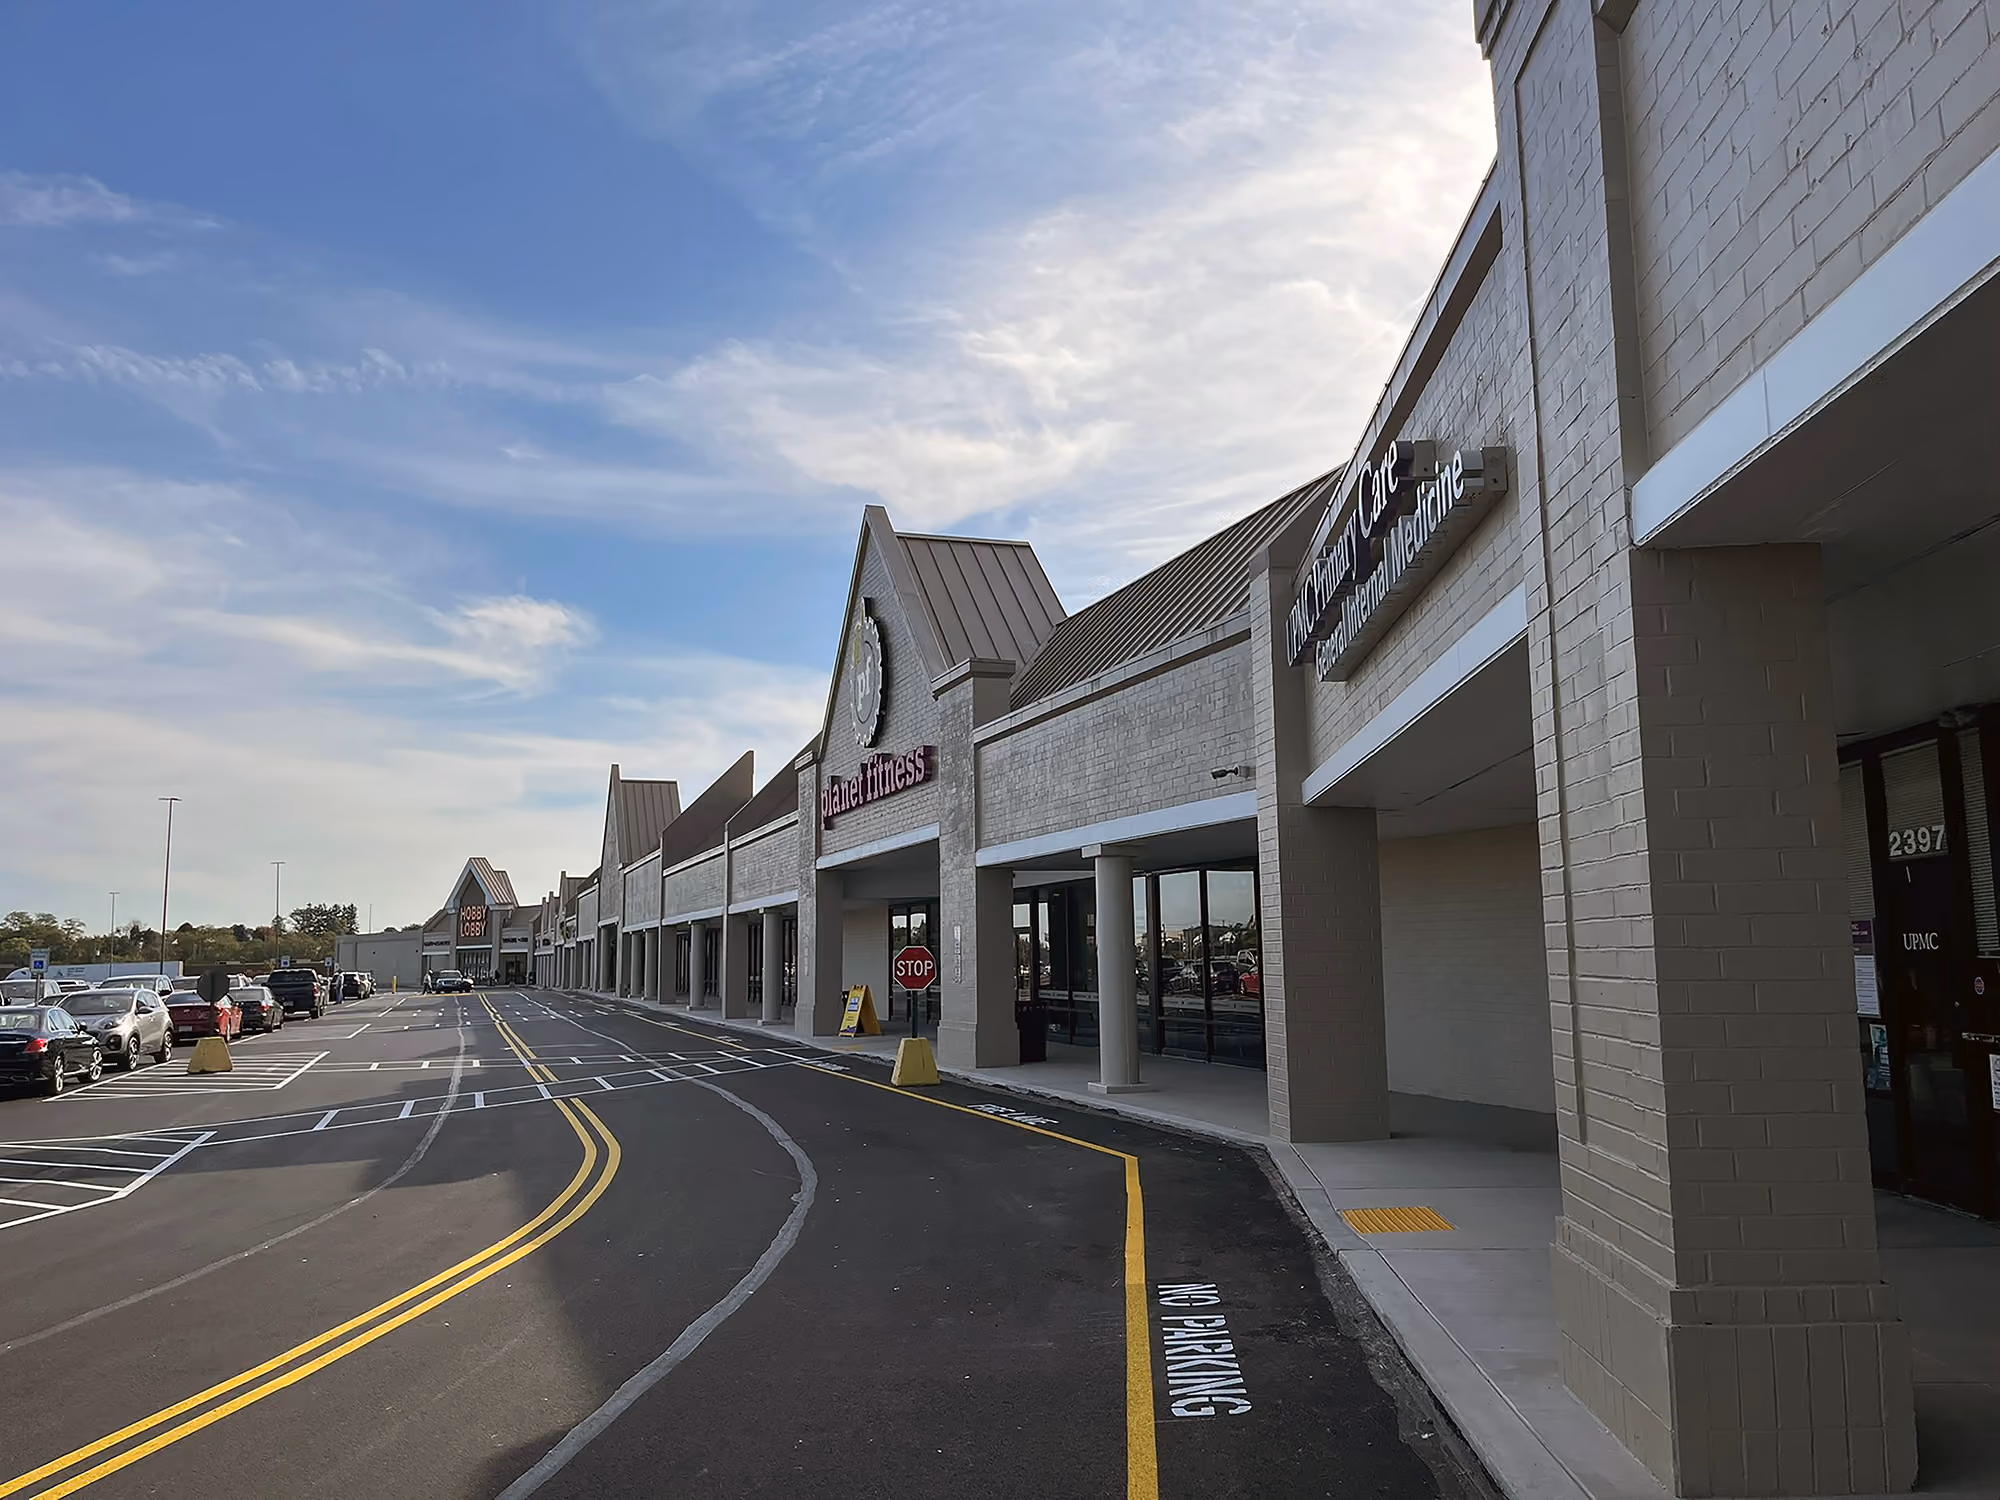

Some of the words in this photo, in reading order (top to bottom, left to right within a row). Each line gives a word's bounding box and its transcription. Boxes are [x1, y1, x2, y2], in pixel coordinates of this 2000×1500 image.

[1286, 574, 1315, 667] UPMC
[1312, 509, 1357, 621] Primary
[1358, 440, 1399, 539] Care
[1315, 601, 1348, 682] General
[1346, 538, 1390, 641] Internal
[1390, 450, 1465, 584] Medicine
[821, 772, 864, 831] planet
[866, 746, 925, 802] fitness
[1889, 824, 1945, 857] 2397
[460, 905, 487, 920] HOBBY
[460, 921, 487, 937] LOBBY
[1902, 932, 1940, 951] UPMC
[896, 960, 934, 977] STOP
[1157, 1283, 1221, 1307] NO
[1160, 1314, 1253, 1417] PARKING
